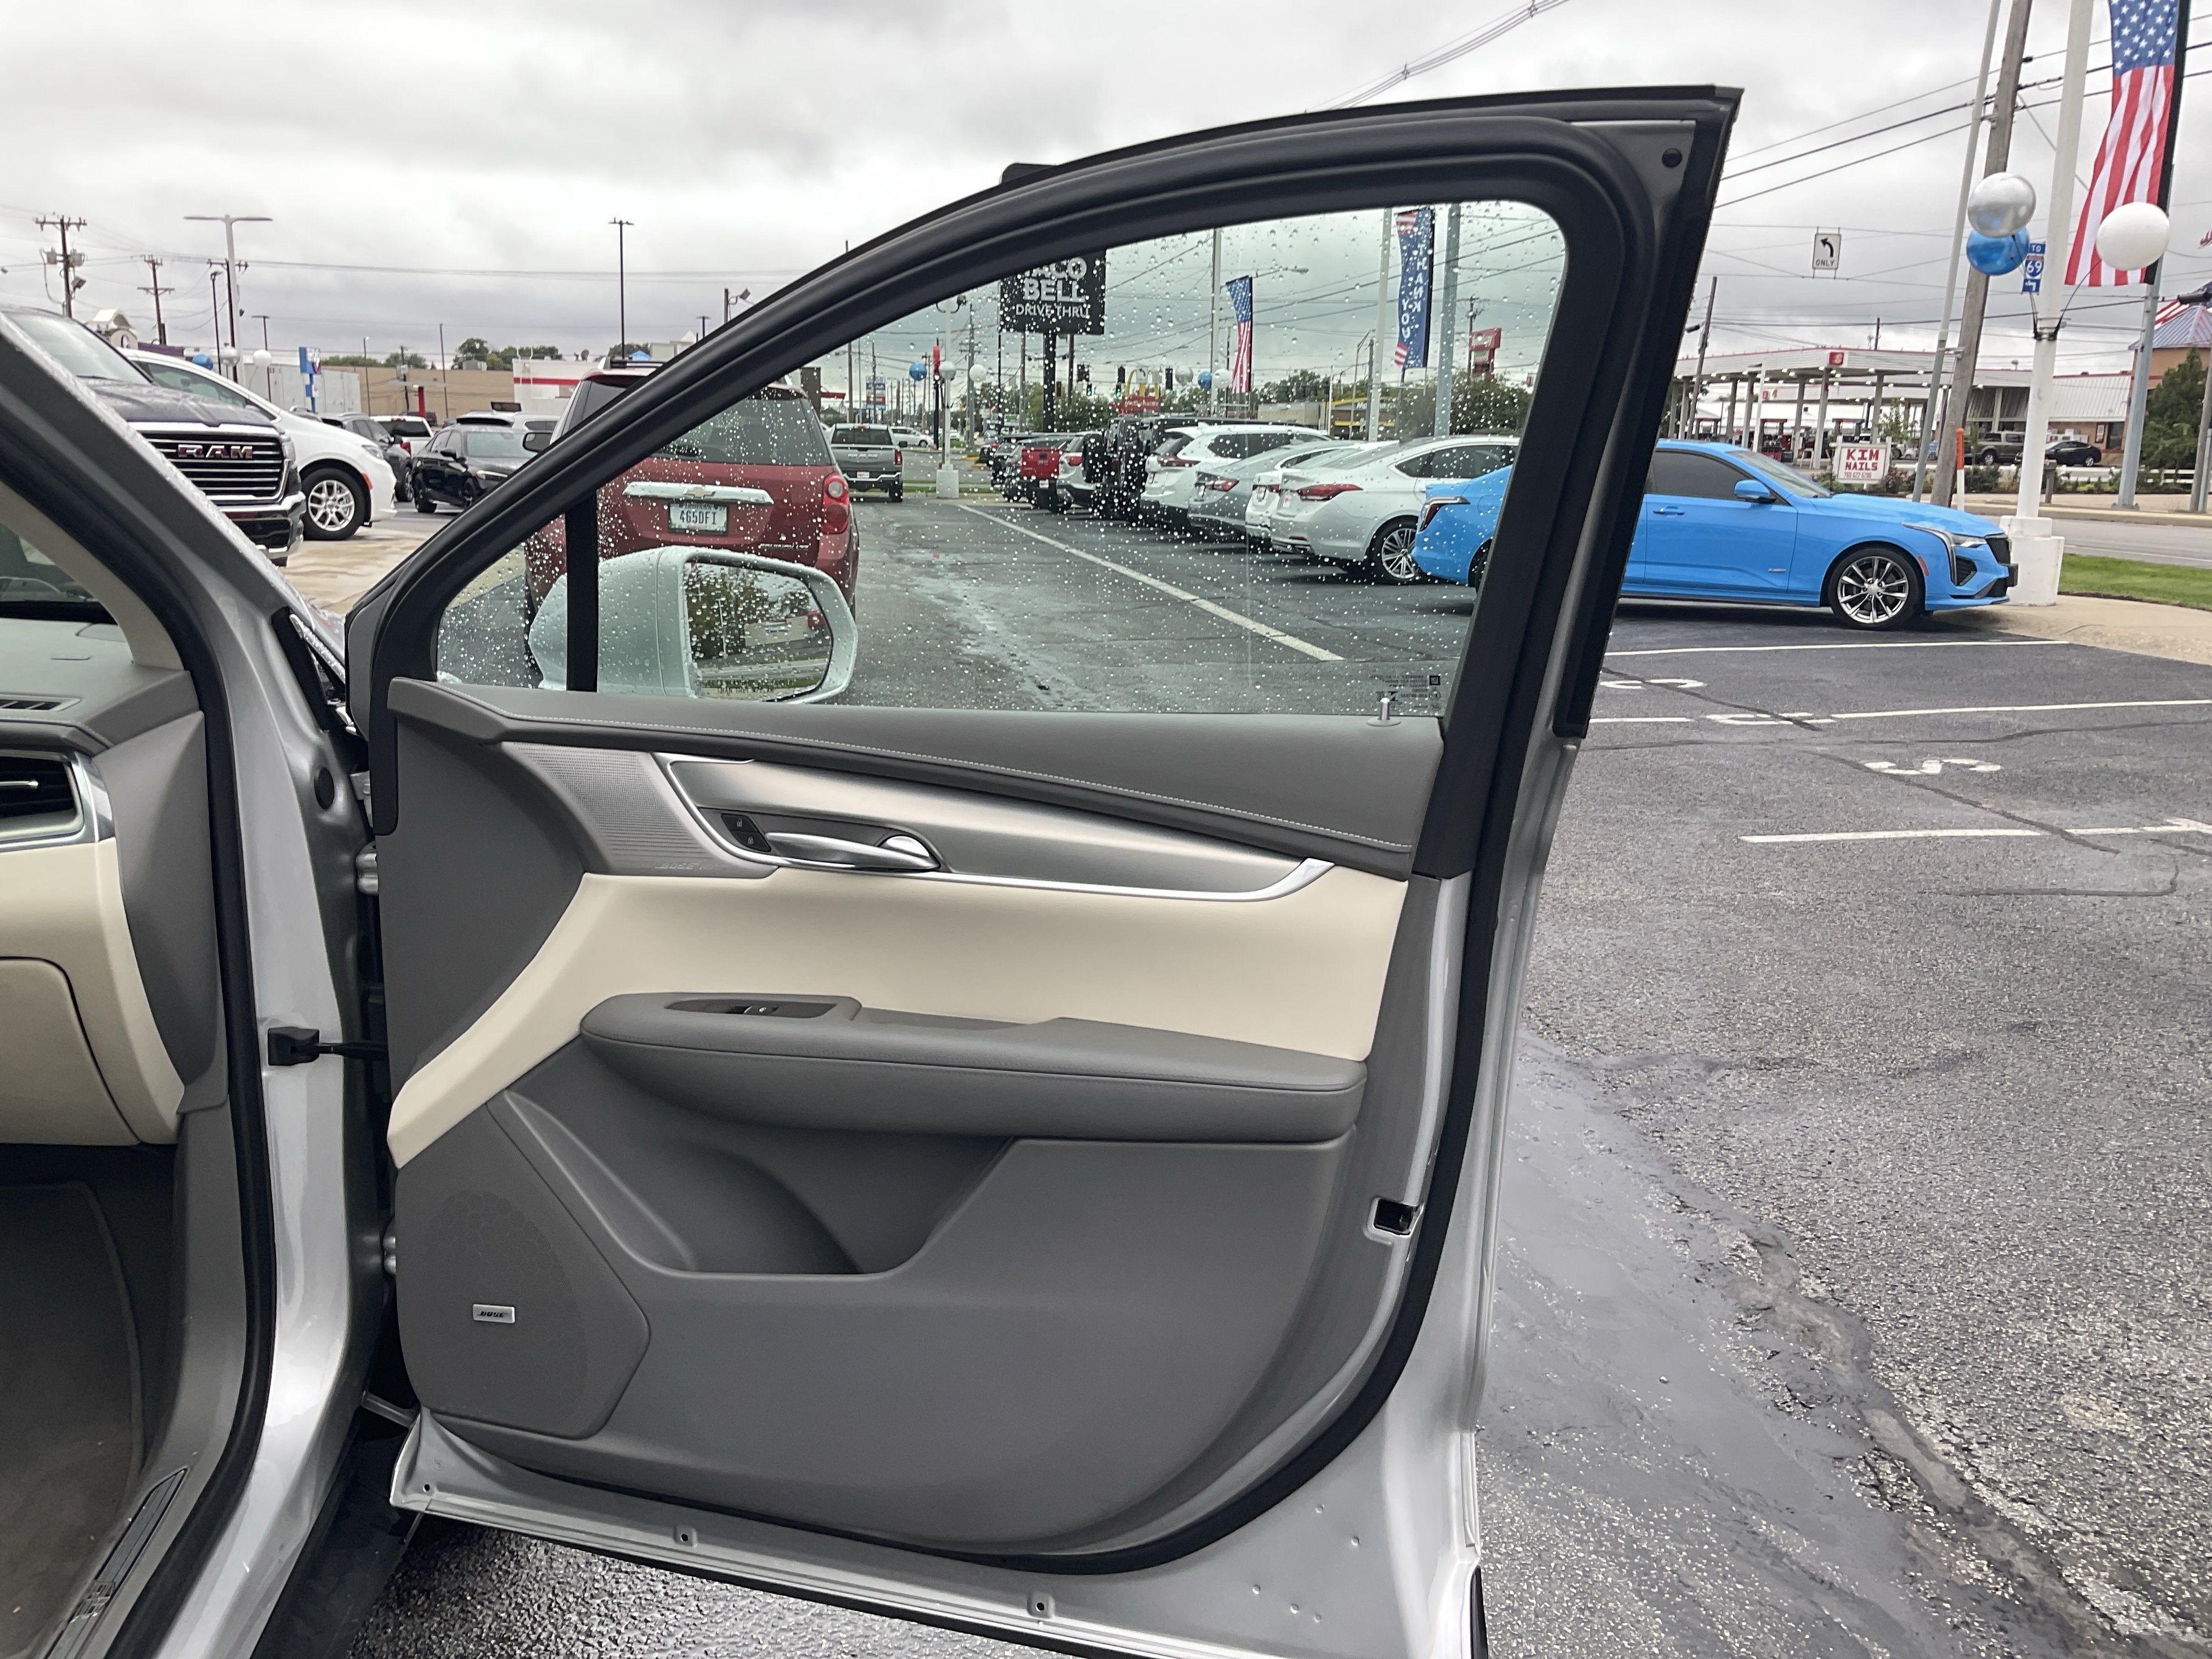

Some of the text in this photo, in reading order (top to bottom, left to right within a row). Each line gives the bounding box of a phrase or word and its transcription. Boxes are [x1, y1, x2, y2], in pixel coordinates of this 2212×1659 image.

[1815, 258, 1835, 267] ONLY
[2027, 260, 2042, 273] 69
[1023, 277, 1086, 302] BELL
[1015, 303, 1090, 319] DRIVE THRU
[178, 444, 253, 459] RAM
[1846, 449, 1879, 460] KIM
[1844, 462, 1878, 471] NAILS
